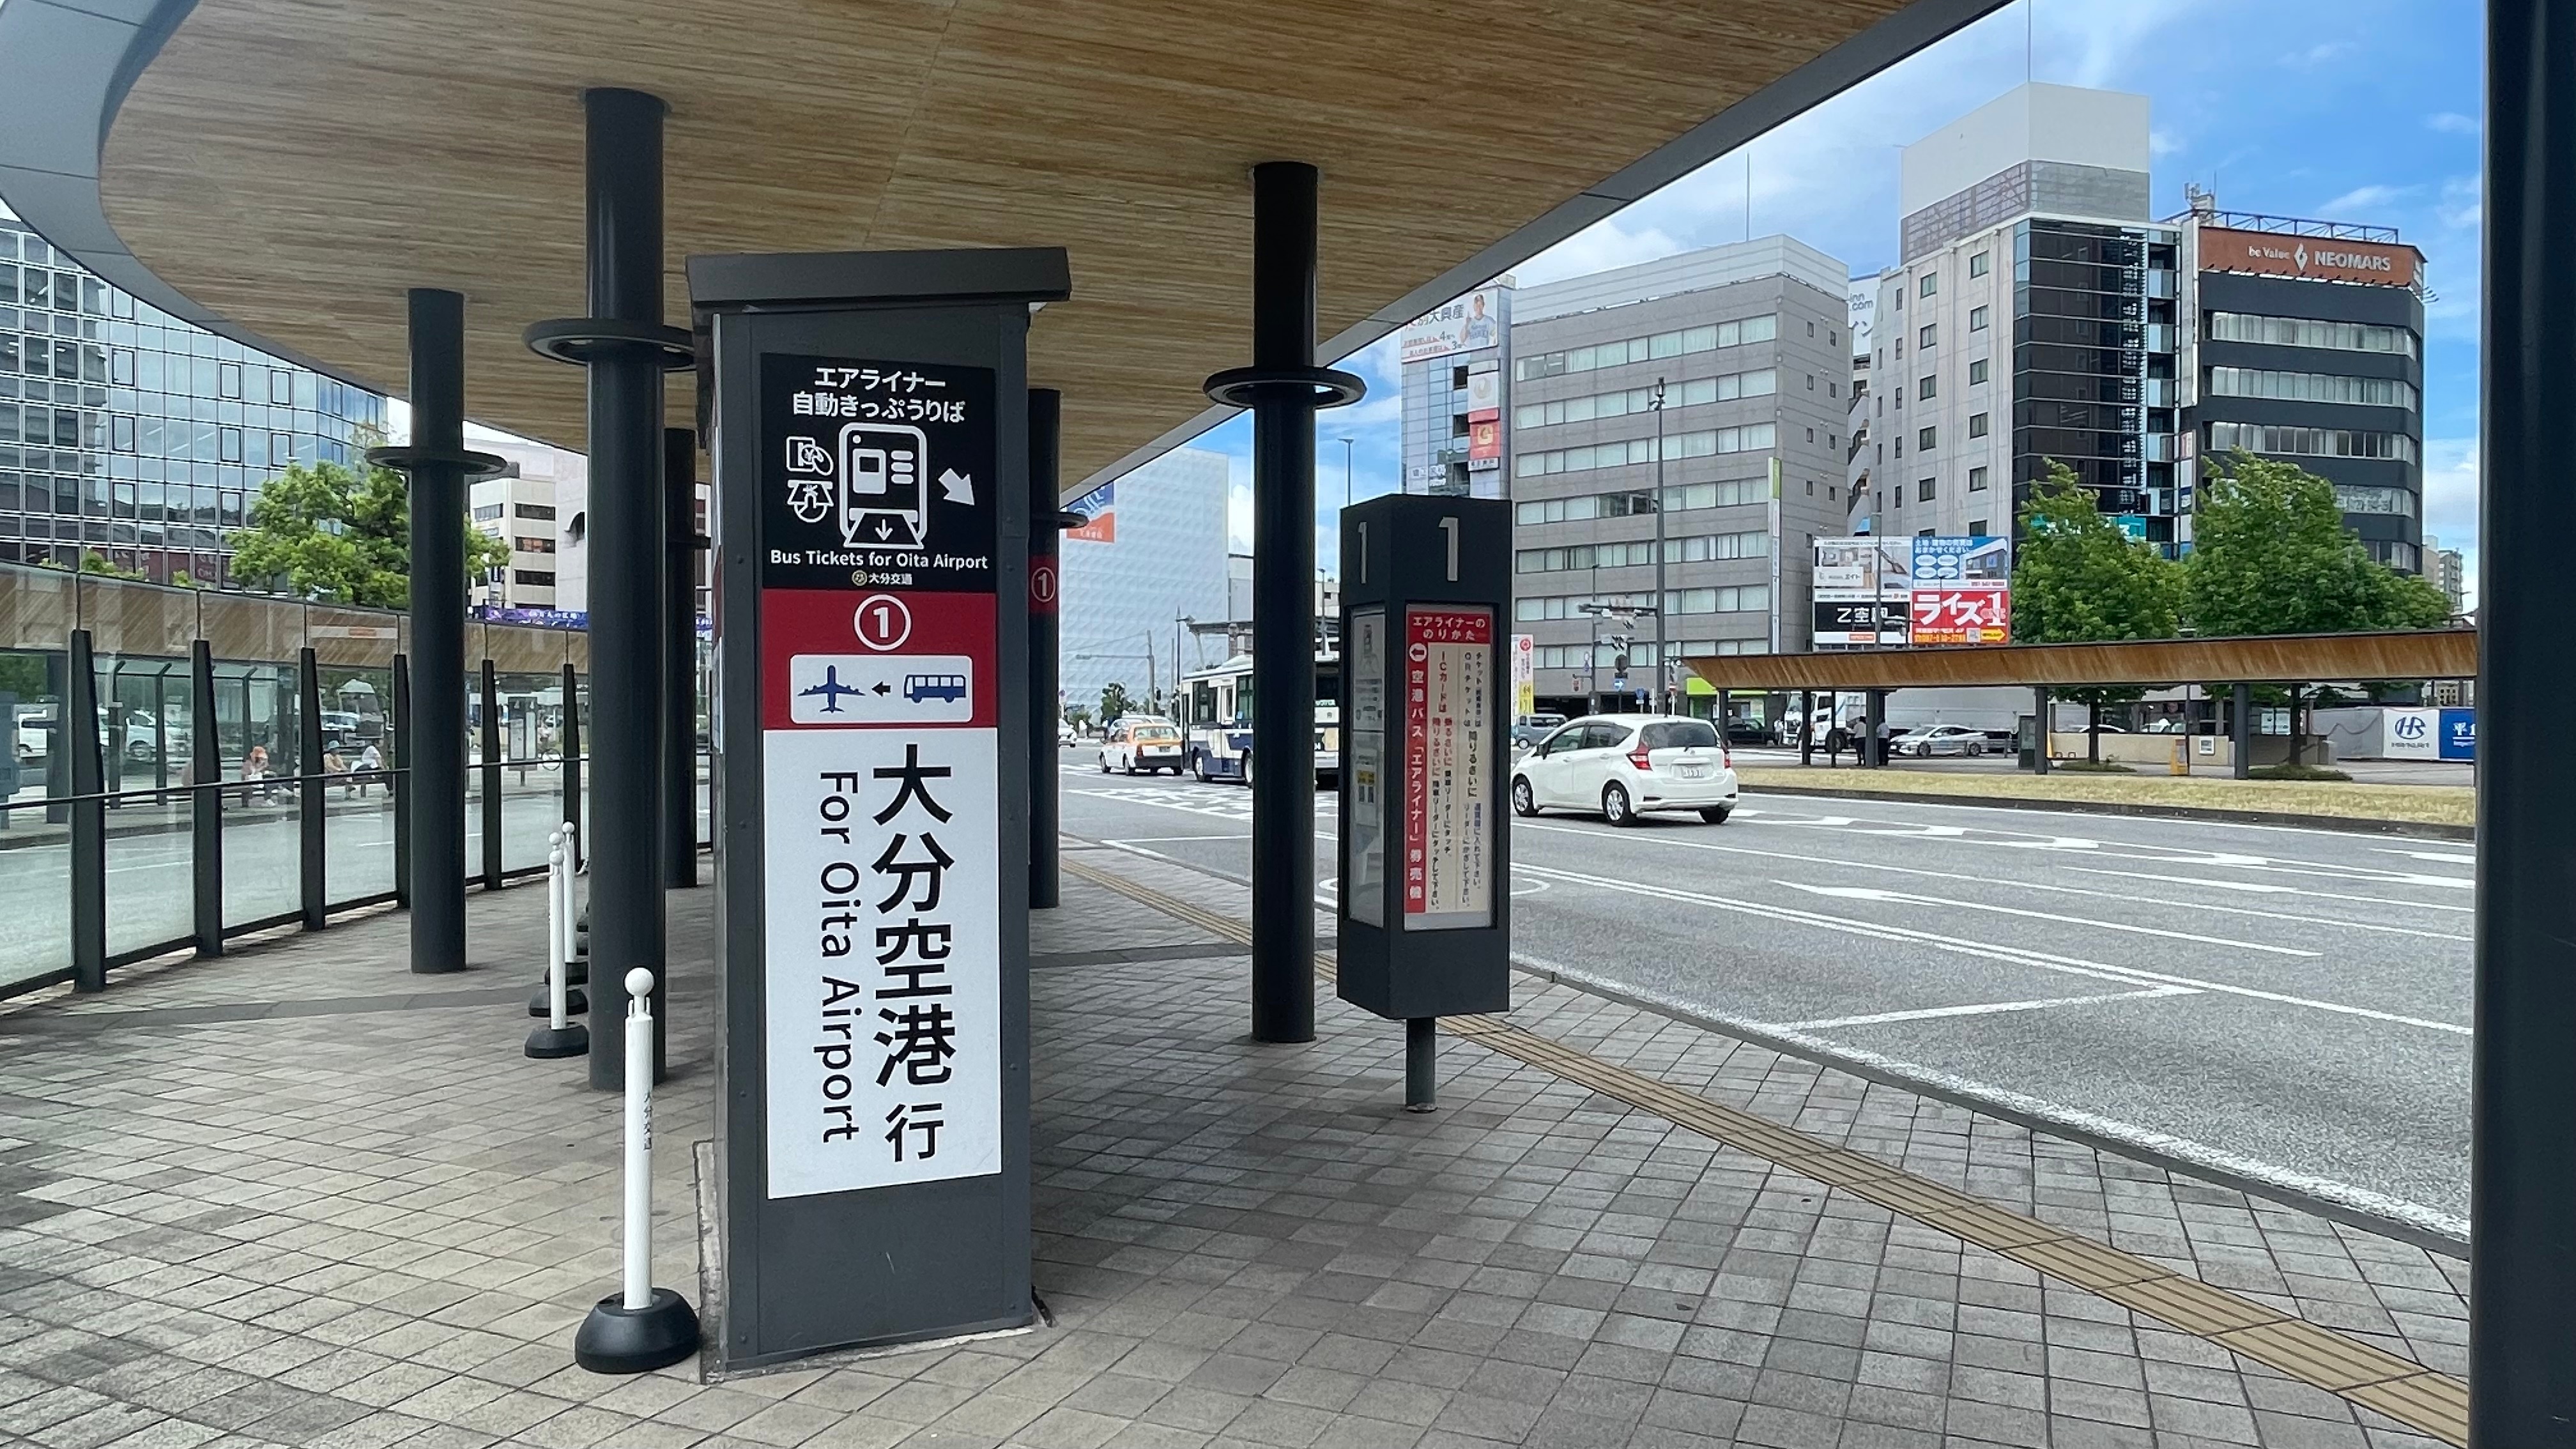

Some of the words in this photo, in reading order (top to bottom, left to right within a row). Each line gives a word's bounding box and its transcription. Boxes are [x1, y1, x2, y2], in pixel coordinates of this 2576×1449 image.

[2248, 245, 2261, 257] be
[2262, 247, 2290, 259] Value
[2314, 250, 2391, 272] NEOMARS
[815, 367, 946, 393] エアライナー
[792, 391, 966, 423] 自動きっぷうりば
[770, 550, 801, 565] Bus
[806, 550, 864, 566] Tickets
[869, 551, 891, 567] for
[896, 553, 929, 568] Oita
[933, 554, 988, 571] Airport
[1358, 521, 1367, 585] 1
[1439, 516, 1459, 581] 1
[873, 607, 890, 638] 1
[1413, 616, 1485, 629] エアライナーの
[1423, 629, 1476, 641] のりかた
[820, 772, 859, 845] For
[820, 862, 860, 958] Oita
[871, 744, 956, 1163] 大分空港行
[813, 976, 860, 1144] Airport
